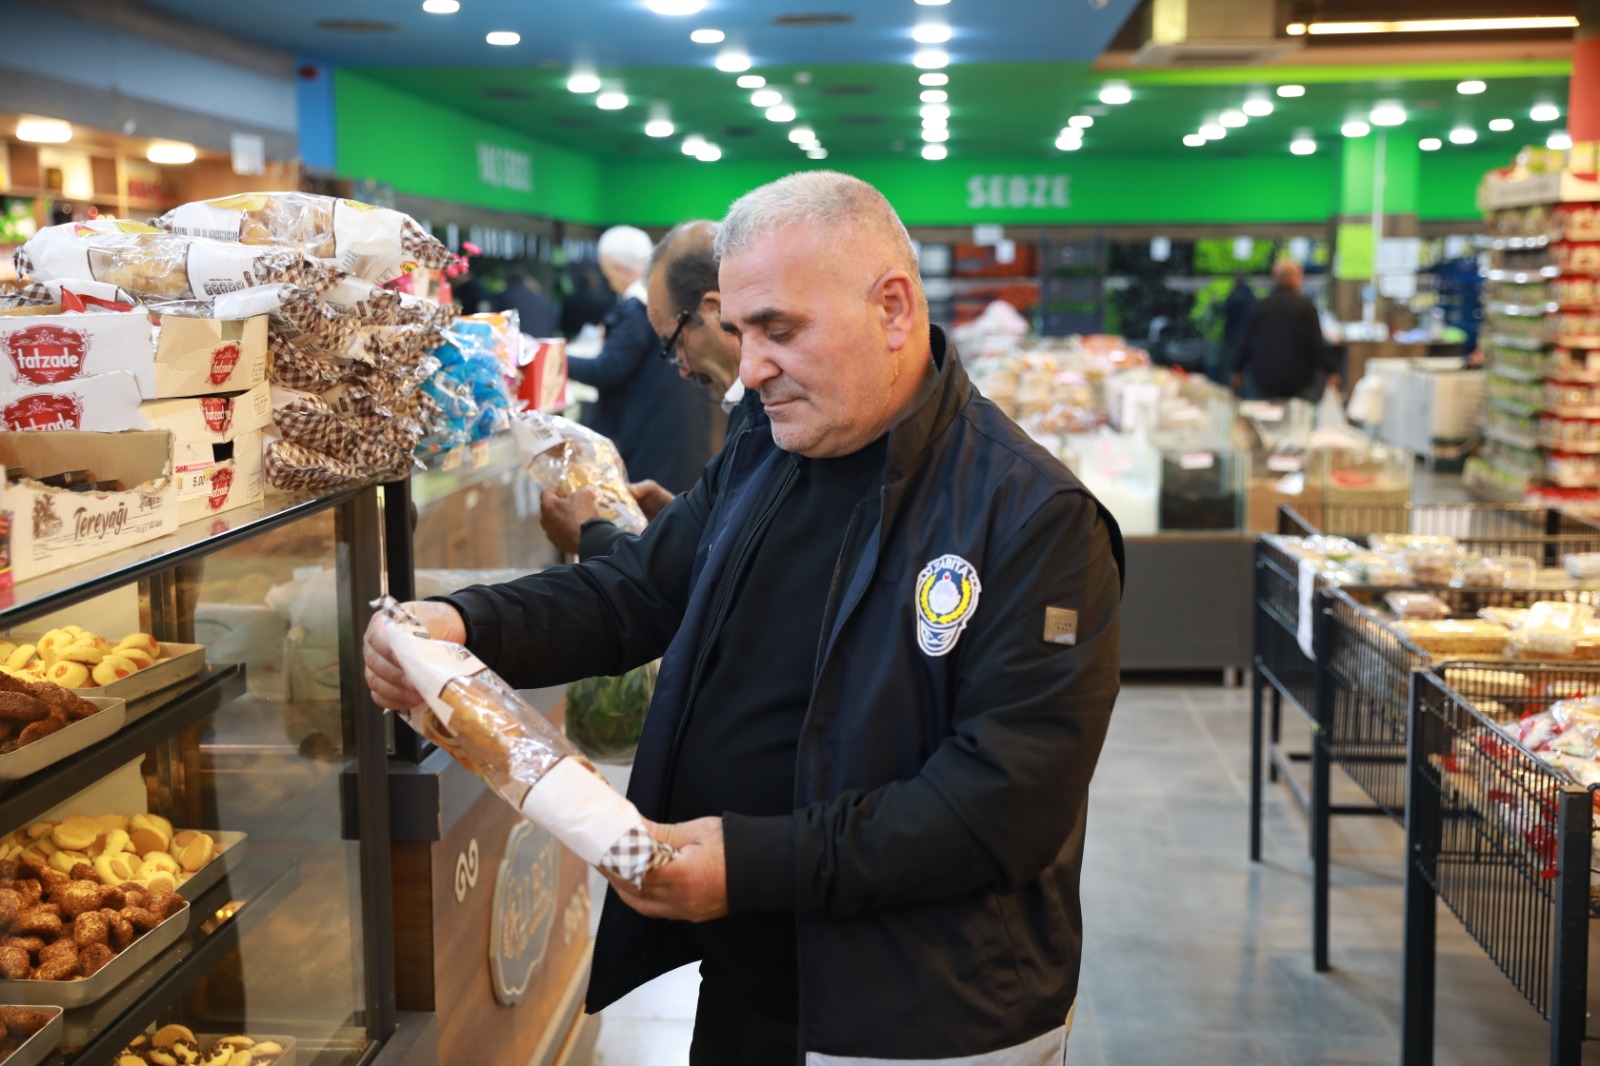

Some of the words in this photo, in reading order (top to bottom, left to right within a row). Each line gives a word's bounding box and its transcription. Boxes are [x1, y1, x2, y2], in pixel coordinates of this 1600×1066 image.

[17, 346, 79, 369] tatzade
[73, 502, 128, 541] Tereyağı
[931, 557, 969, 580] ZABITA
